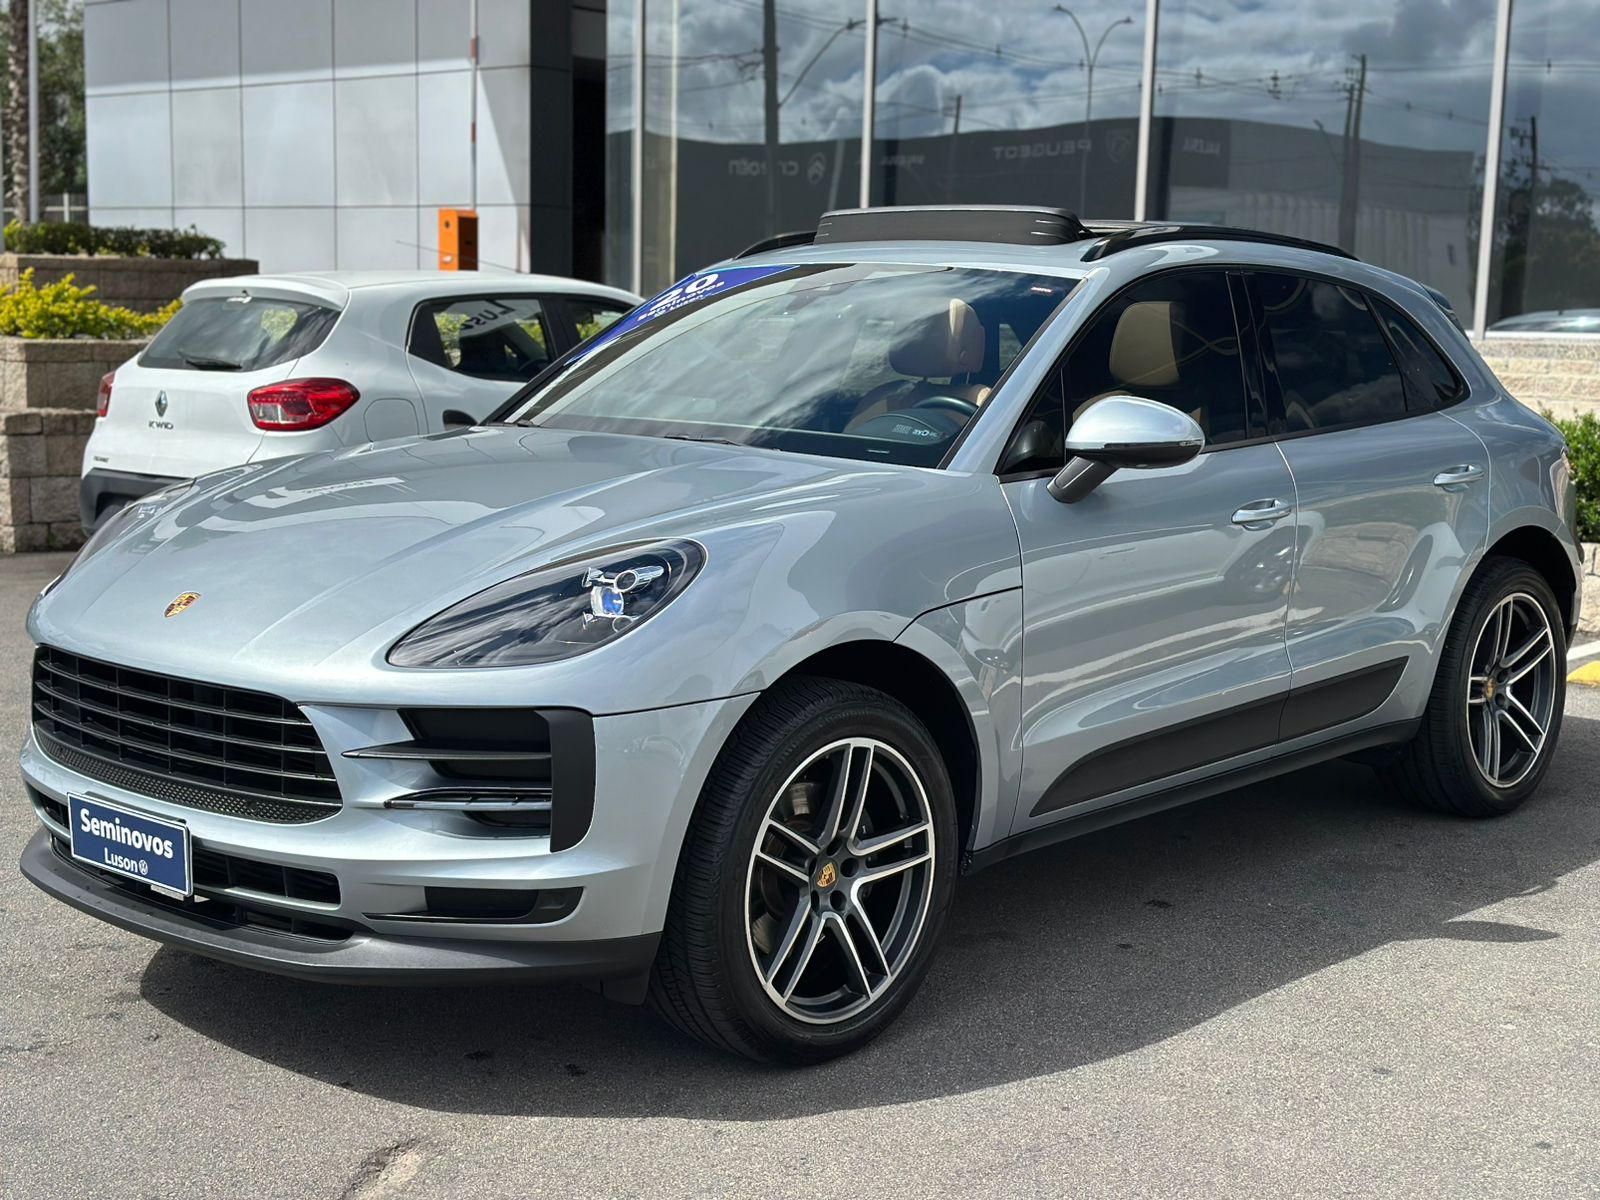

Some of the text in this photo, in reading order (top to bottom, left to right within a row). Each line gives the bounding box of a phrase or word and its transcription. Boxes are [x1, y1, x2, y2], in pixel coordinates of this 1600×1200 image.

[148, 420, 174, 430] KWID
[80, 808, 173, 859] Seminovos
[104, 847, 139, 873] Luson
